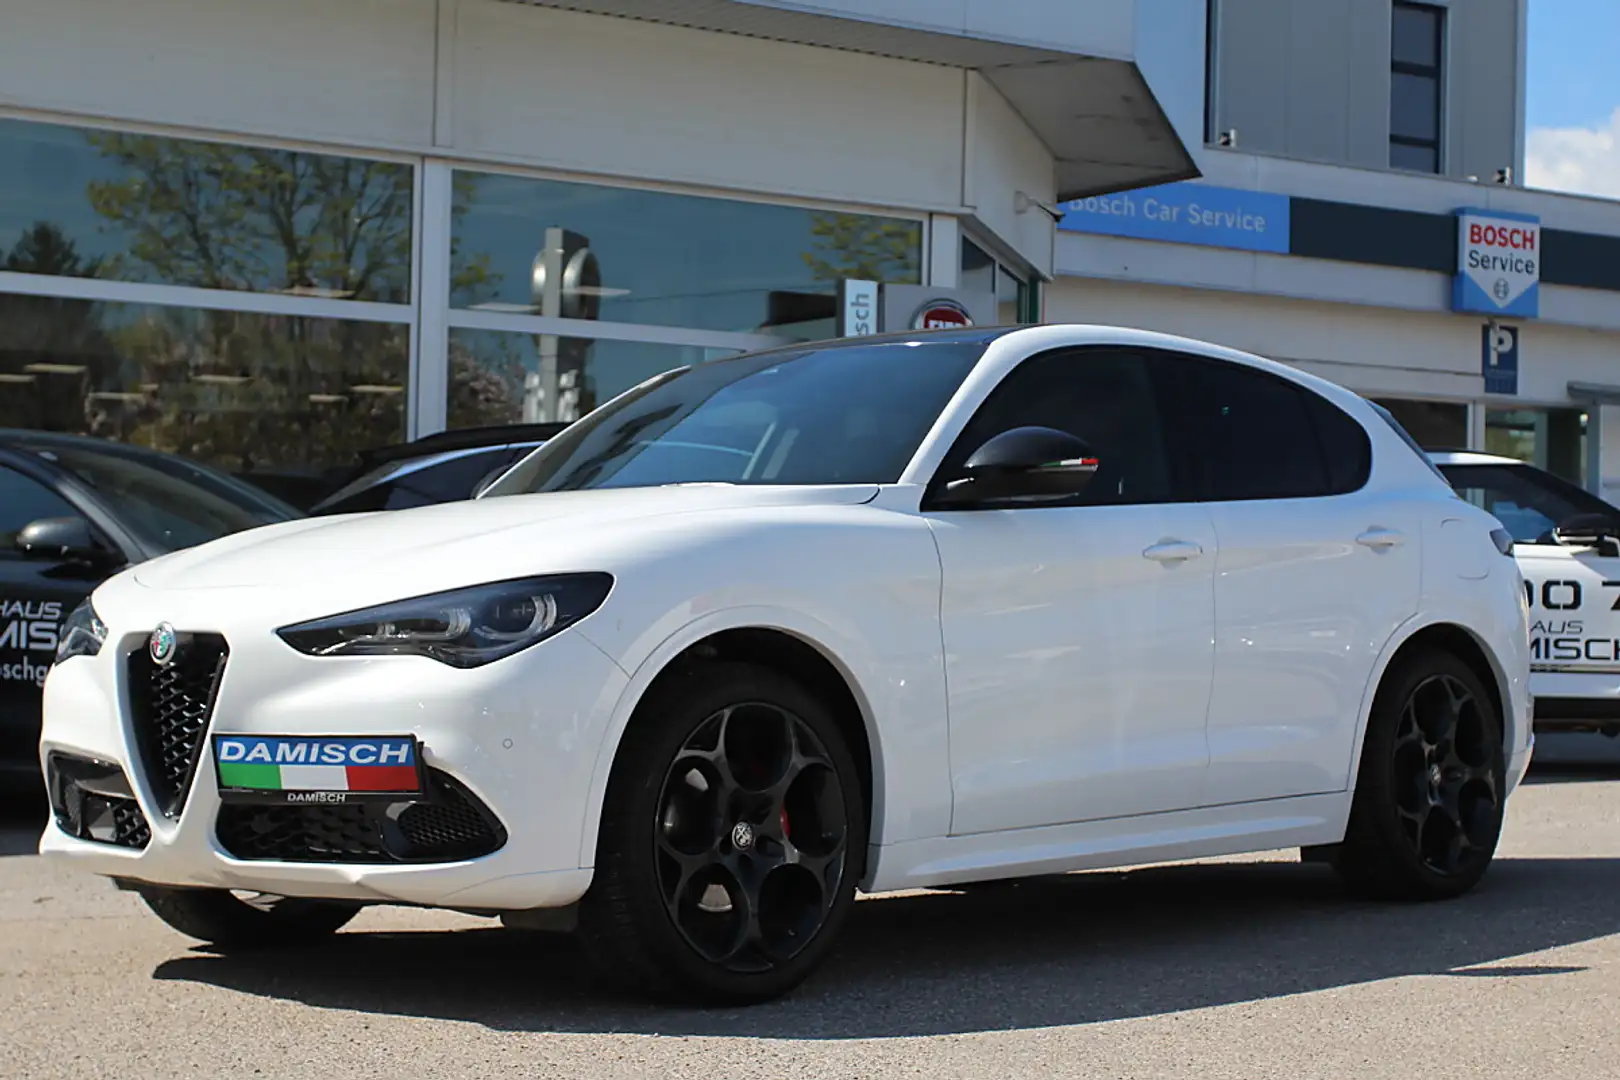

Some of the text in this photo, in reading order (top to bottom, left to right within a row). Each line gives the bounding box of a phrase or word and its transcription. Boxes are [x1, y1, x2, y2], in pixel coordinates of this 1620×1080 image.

[1068, 195, 1267, 233] Bosch Car Service
[1469, 222, 1536, 251] BOSCH
[1468, 249, 1536, 276] Service
[219, 740, 410, 764] DAMISCH
[286, 791, 347, 803] DAMISCH
